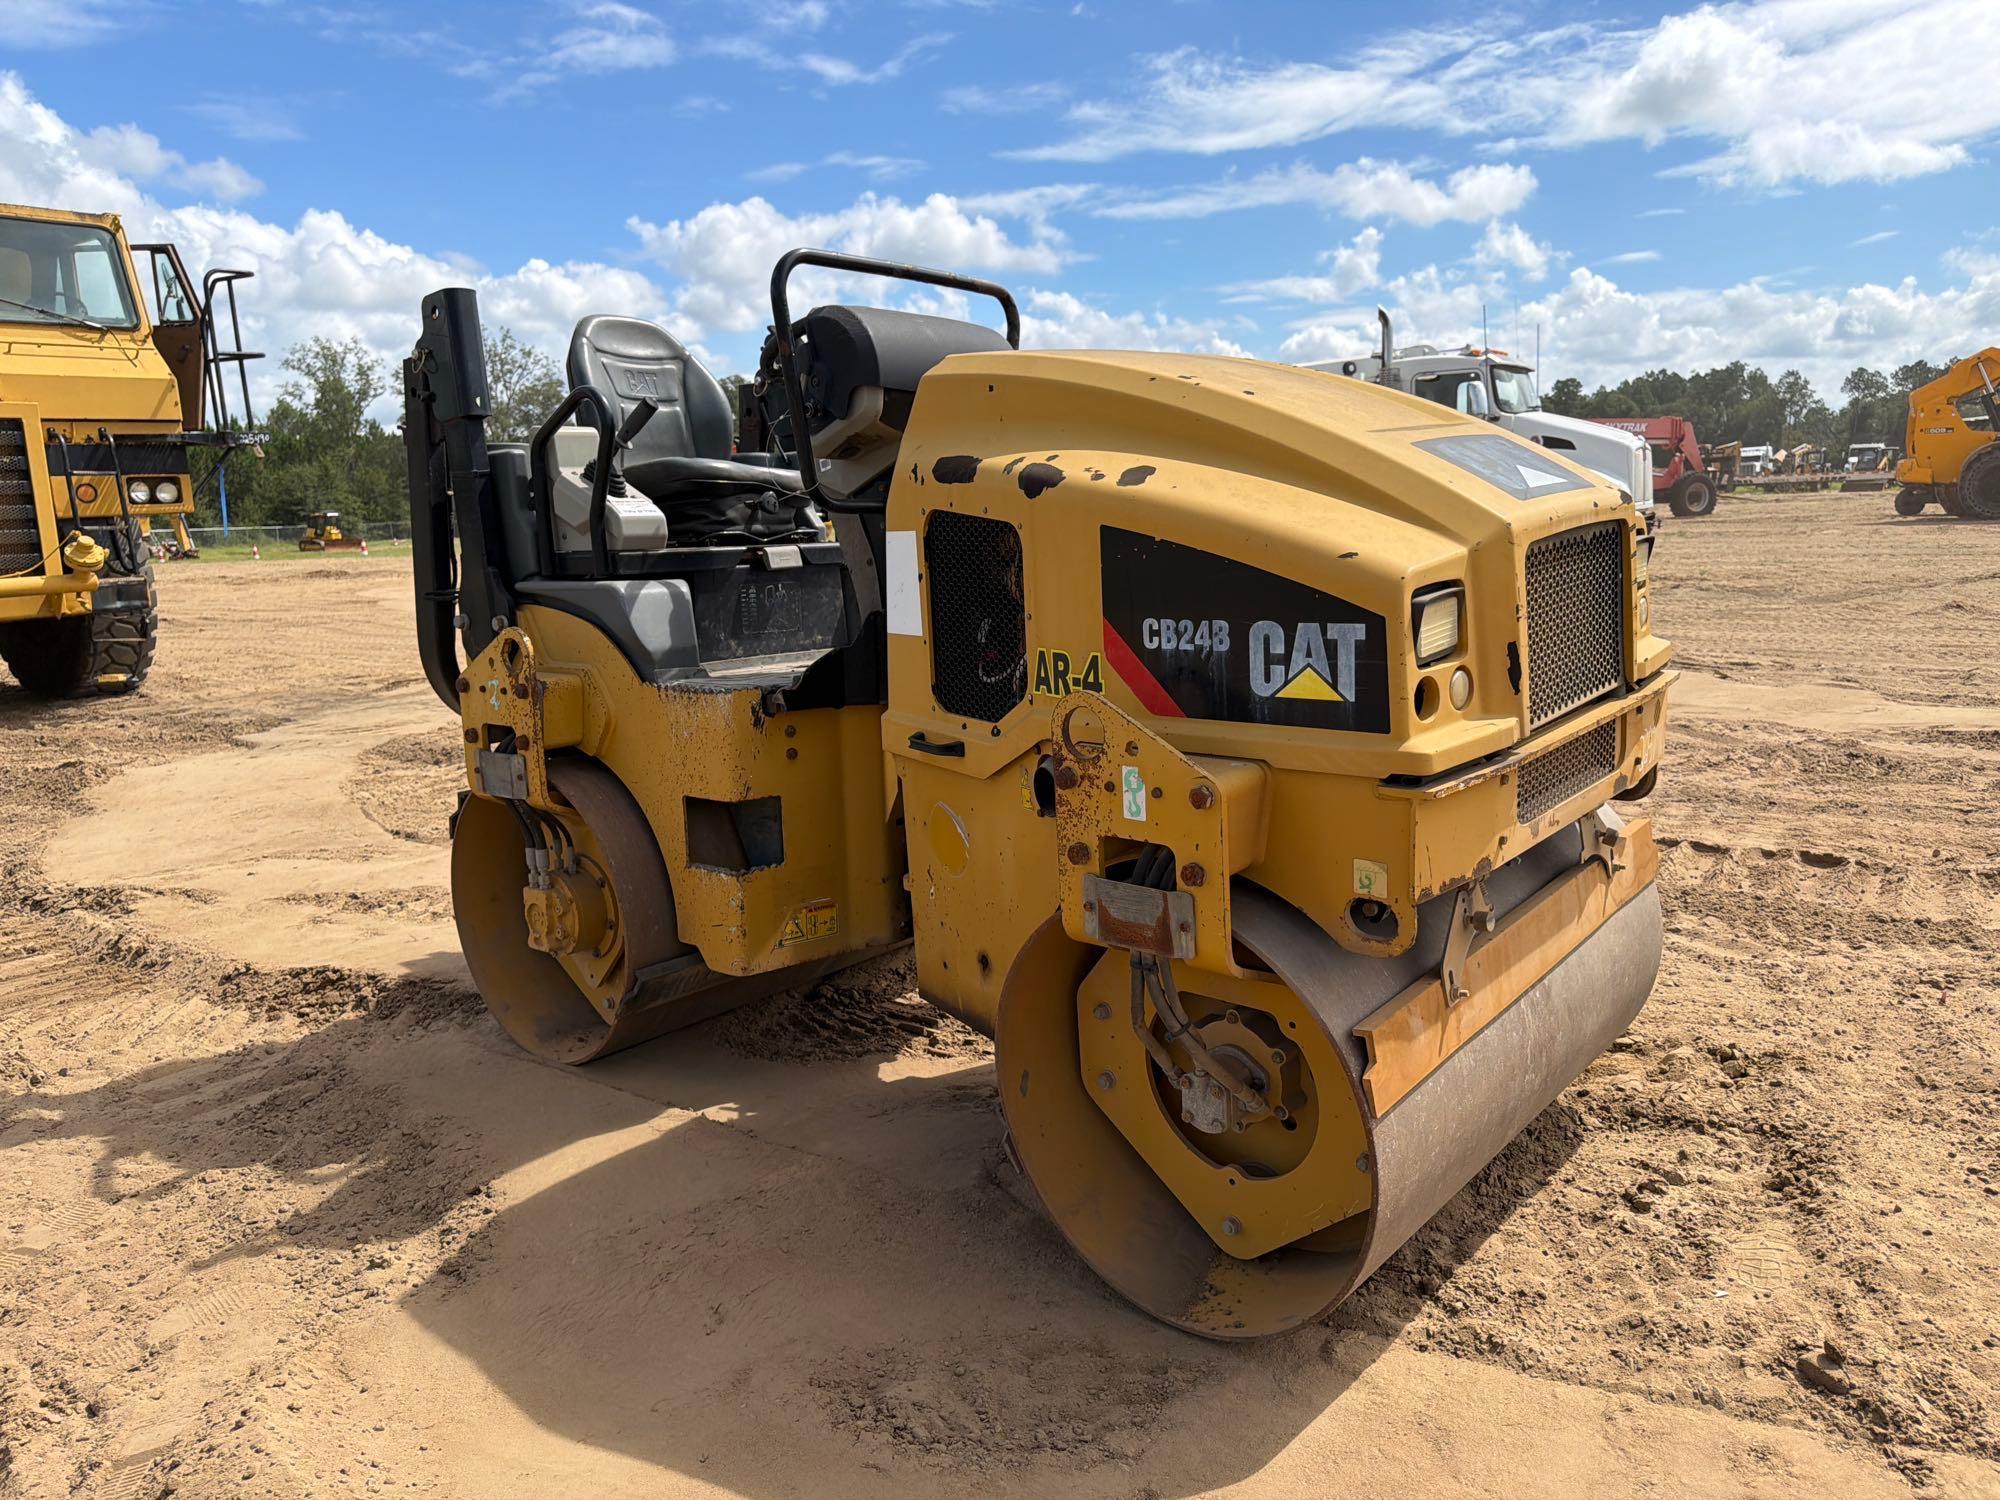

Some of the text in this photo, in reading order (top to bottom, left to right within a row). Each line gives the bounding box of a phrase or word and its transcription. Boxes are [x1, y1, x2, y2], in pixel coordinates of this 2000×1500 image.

[624, 369, 659, 397] CAT
[1034, 648, 1104, 698] AR-4
[1142, 617, 1366, 702] CB24B CAT
